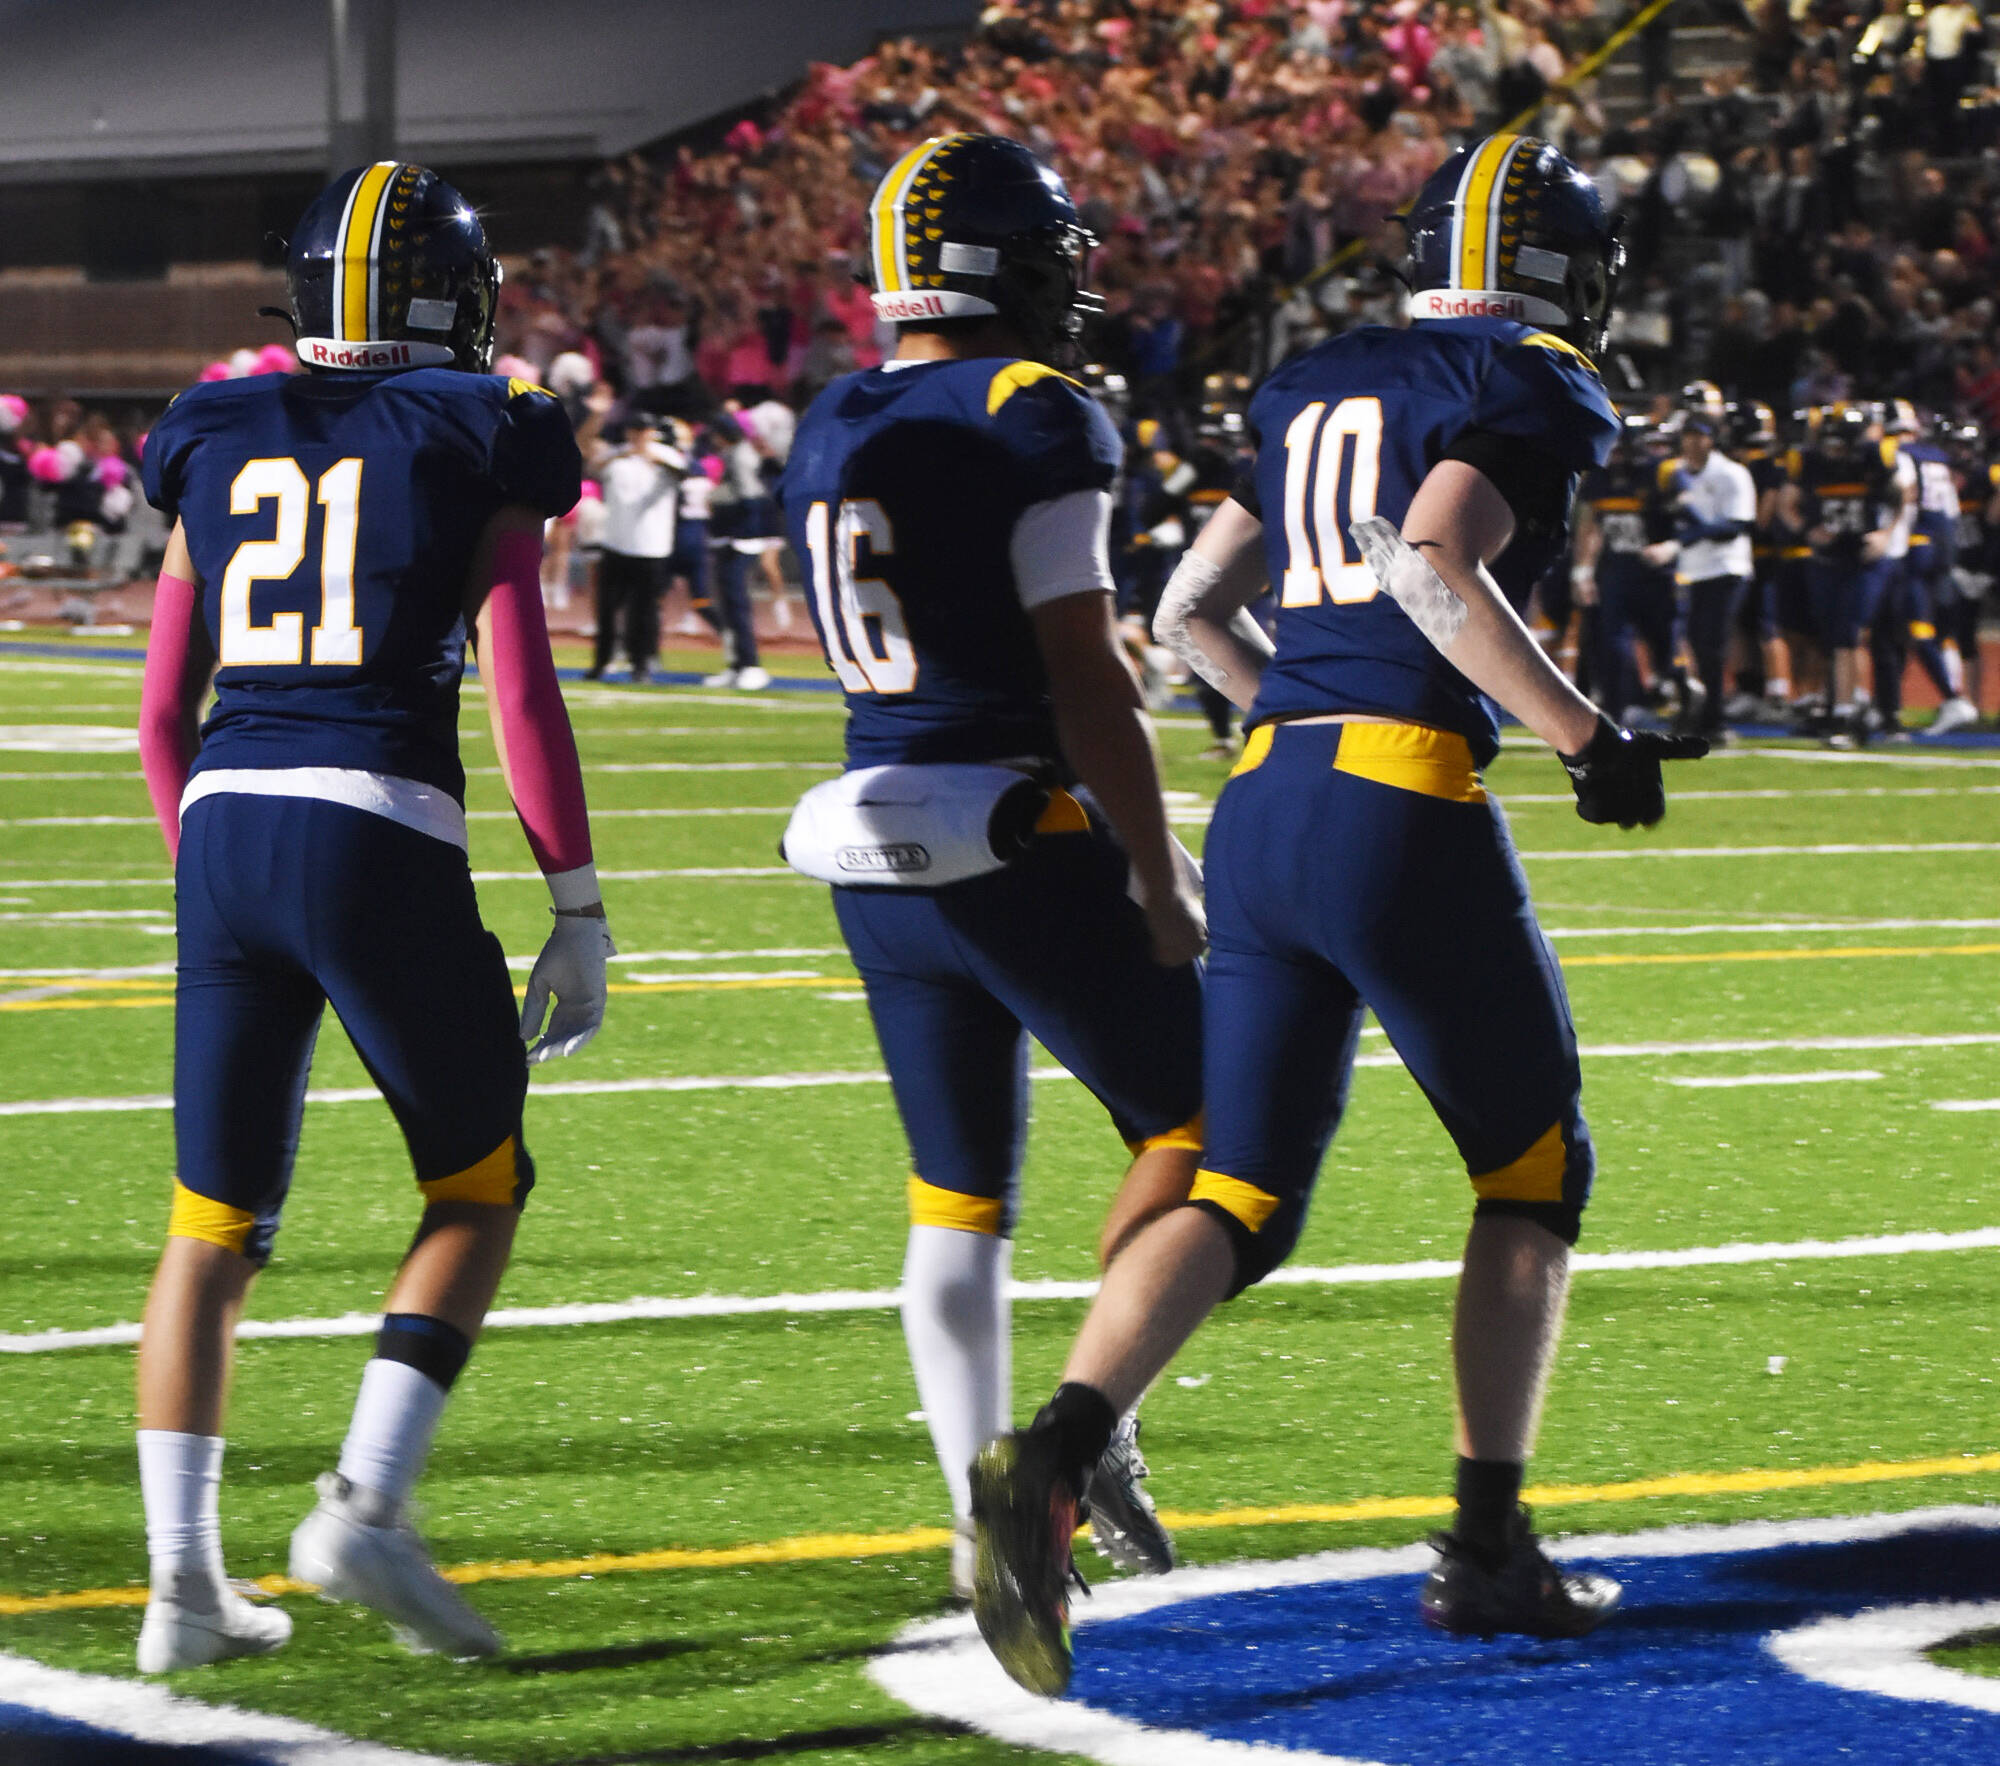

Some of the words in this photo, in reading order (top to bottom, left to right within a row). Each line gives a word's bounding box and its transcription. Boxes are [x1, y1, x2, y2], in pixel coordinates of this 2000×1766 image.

[312, 343, 410, 367] Riddell
[1429, 296, 1525, 318] Riddell
[219, 457, 363, 667] 21
[806, 498, 919, 694] 16
[1281, 396, 1384, 608] 10
